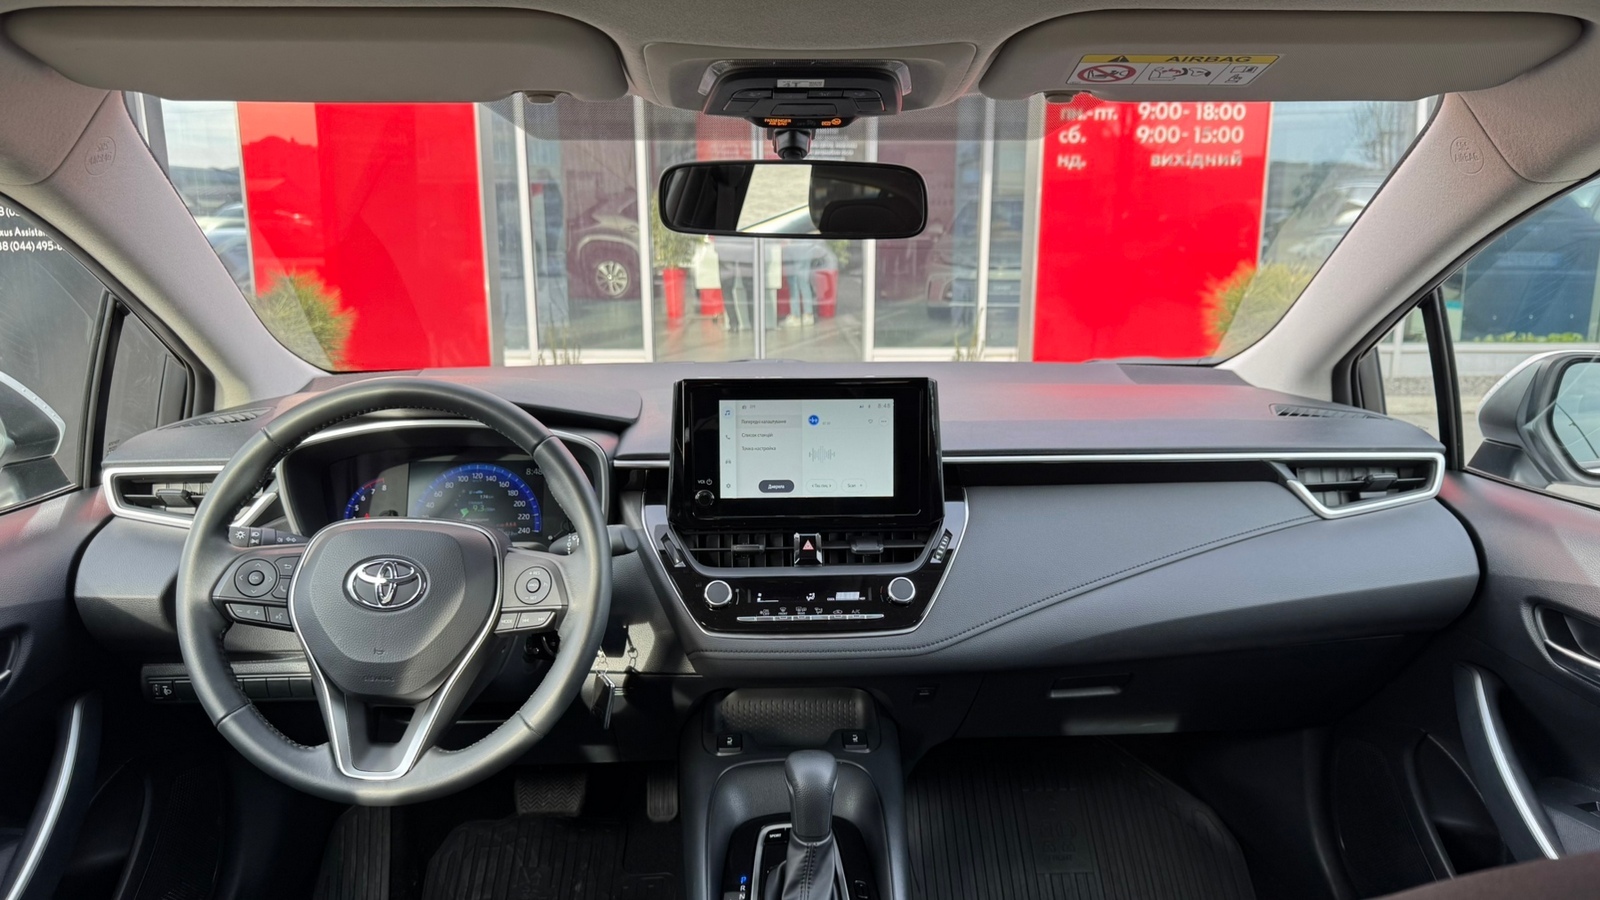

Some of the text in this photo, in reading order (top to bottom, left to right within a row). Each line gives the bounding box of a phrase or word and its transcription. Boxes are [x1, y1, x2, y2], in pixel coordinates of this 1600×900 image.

[1165, 55, 1252, 63] AIRBAG
[1196, 103, 1246, 120] 18:00
[1058, 125, 1087, 144] сб.
[1194, 126, 1244, 144] 15:00
[1057, 152, 1242, 170] нд. вихідний
[9, 241, 35, 253] (044)
[472, 472, 484, 480] 120
[525, 467, 543, 476] 8:48
[507, 489, 519, 497] 180
[741, 876, 747, 884] P
